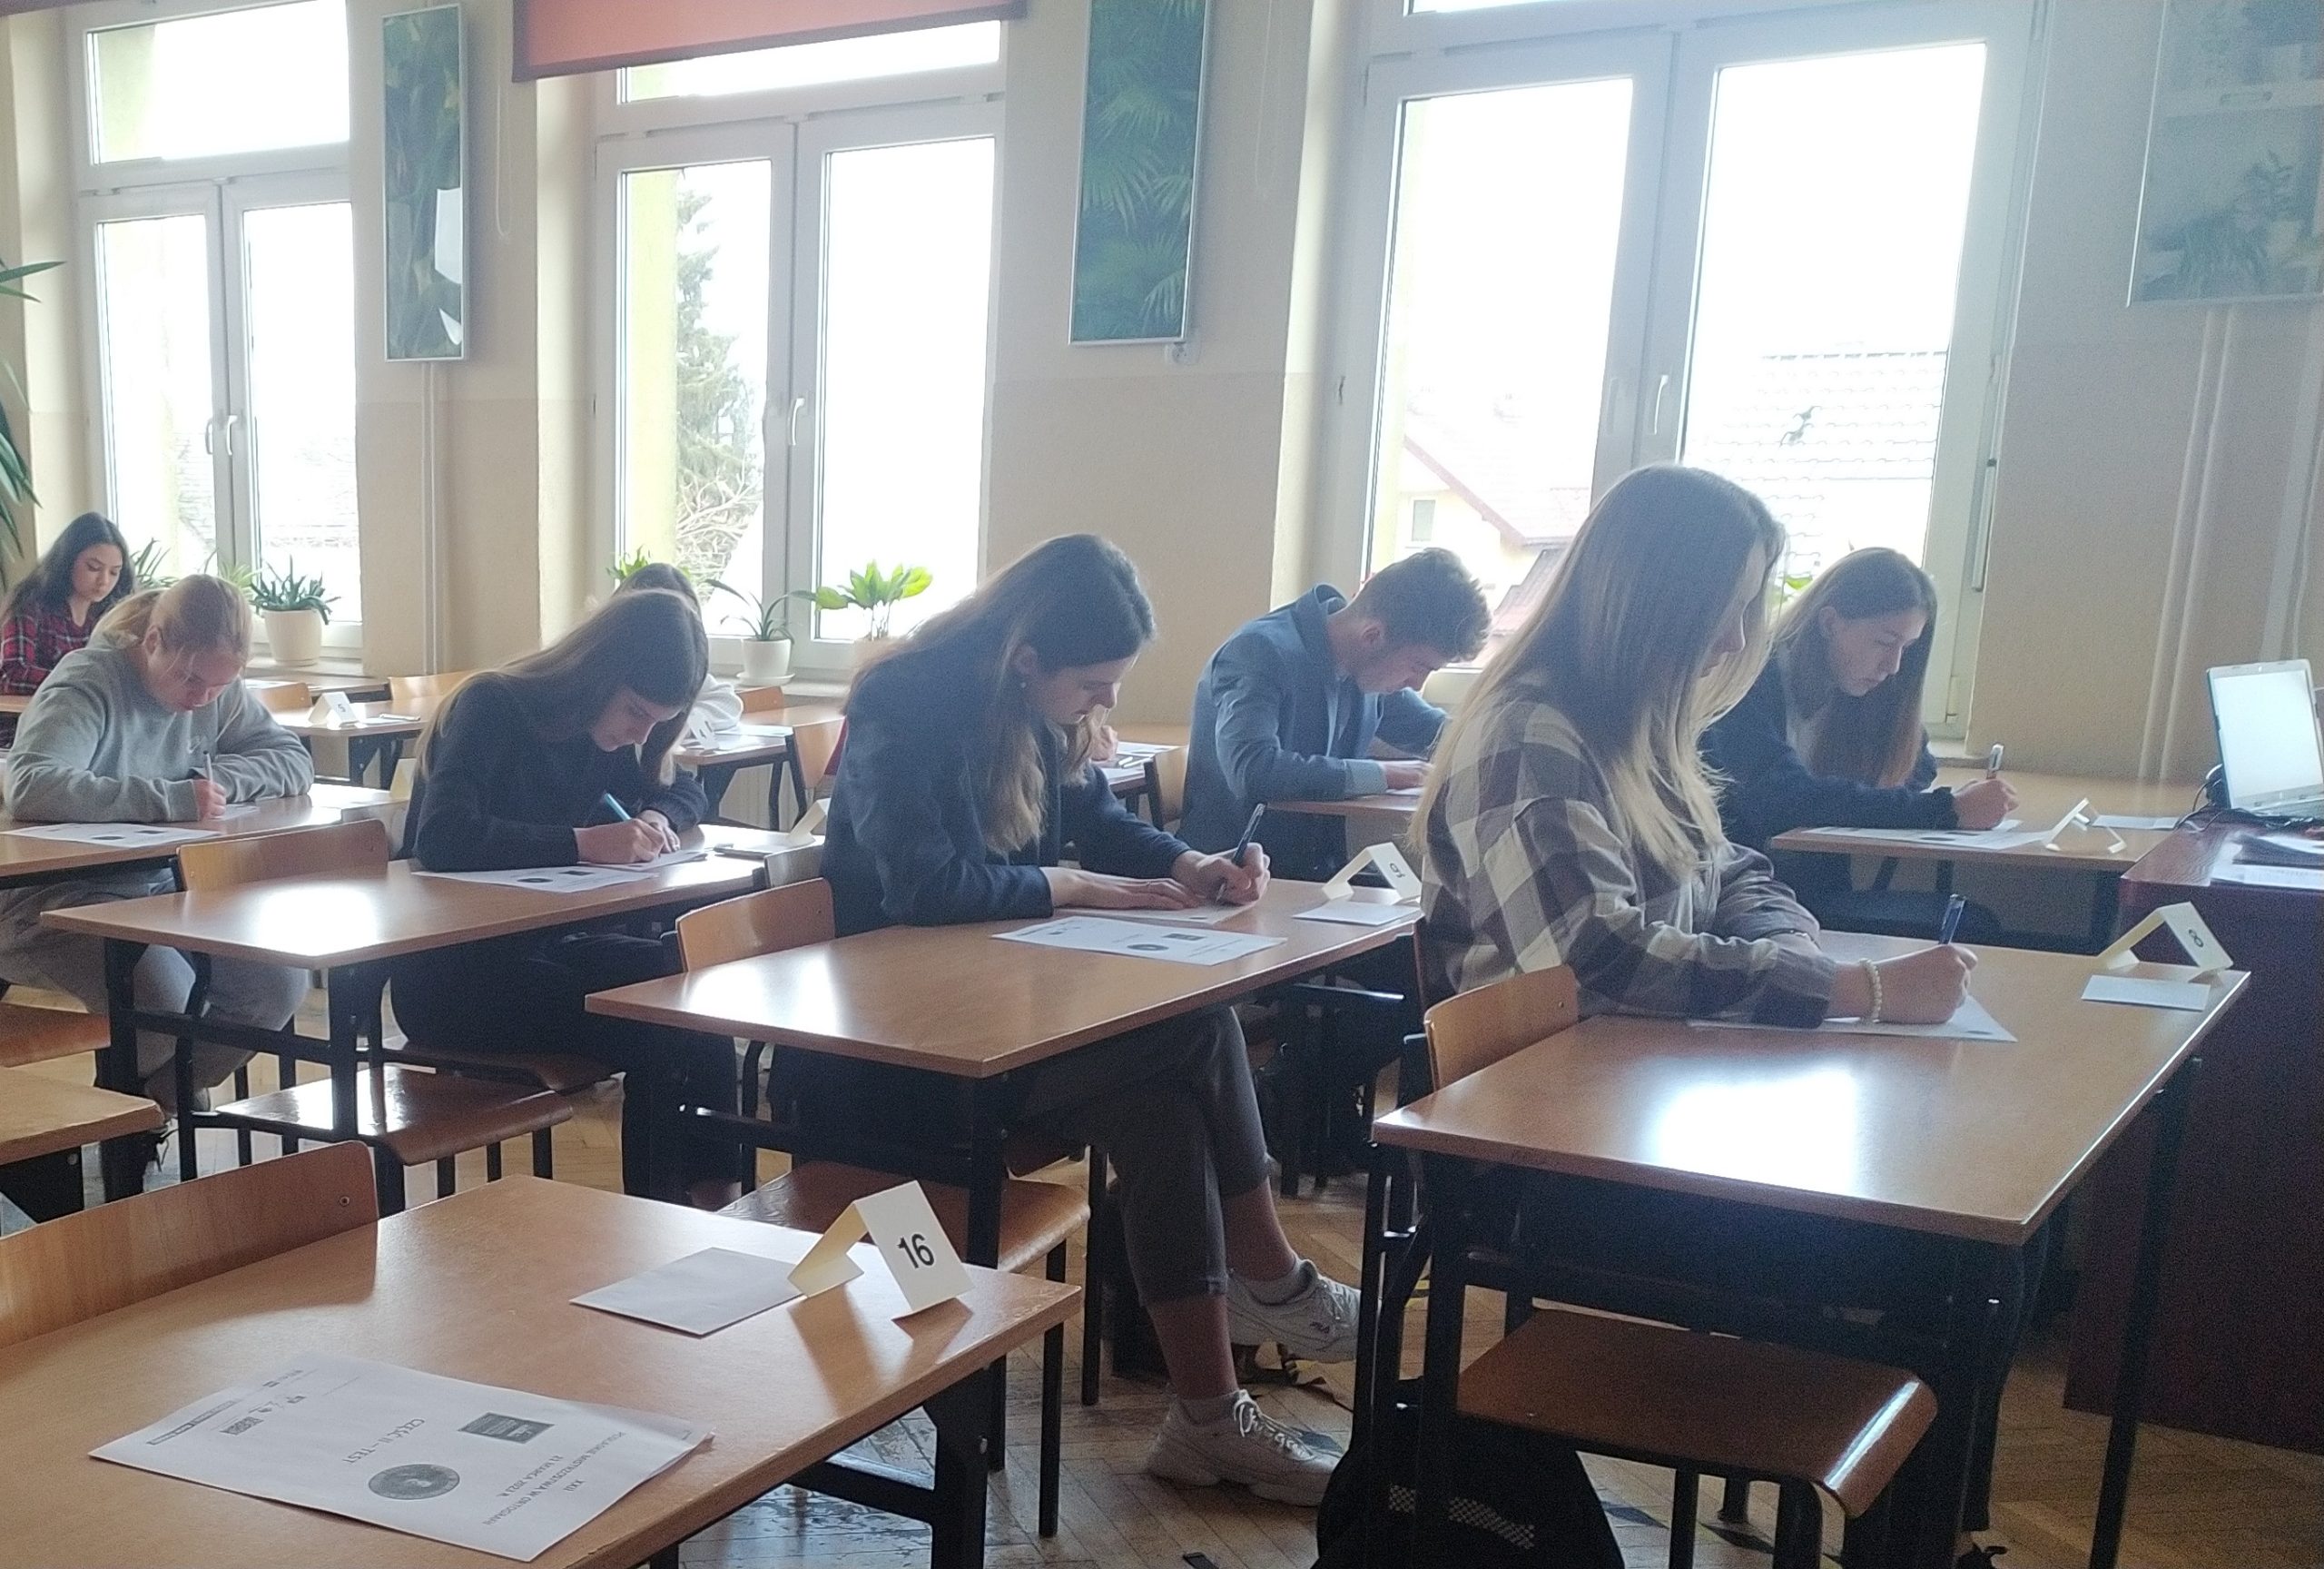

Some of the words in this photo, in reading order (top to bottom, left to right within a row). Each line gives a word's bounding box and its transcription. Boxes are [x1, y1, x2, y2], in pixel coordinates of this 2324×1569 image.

[337, 703, 346, 713] 5
[1390, 863, 1405, 878] 9
[2189, 929, 2204, 948] 8
[896, 1233, 934, 1268] 16
[387, 1418, 426, 1438] CZĘŚĆ
[341, 1447, 376, 1464] TEST
[534, 1454, 591, 1490] MISTRZOSTWA
